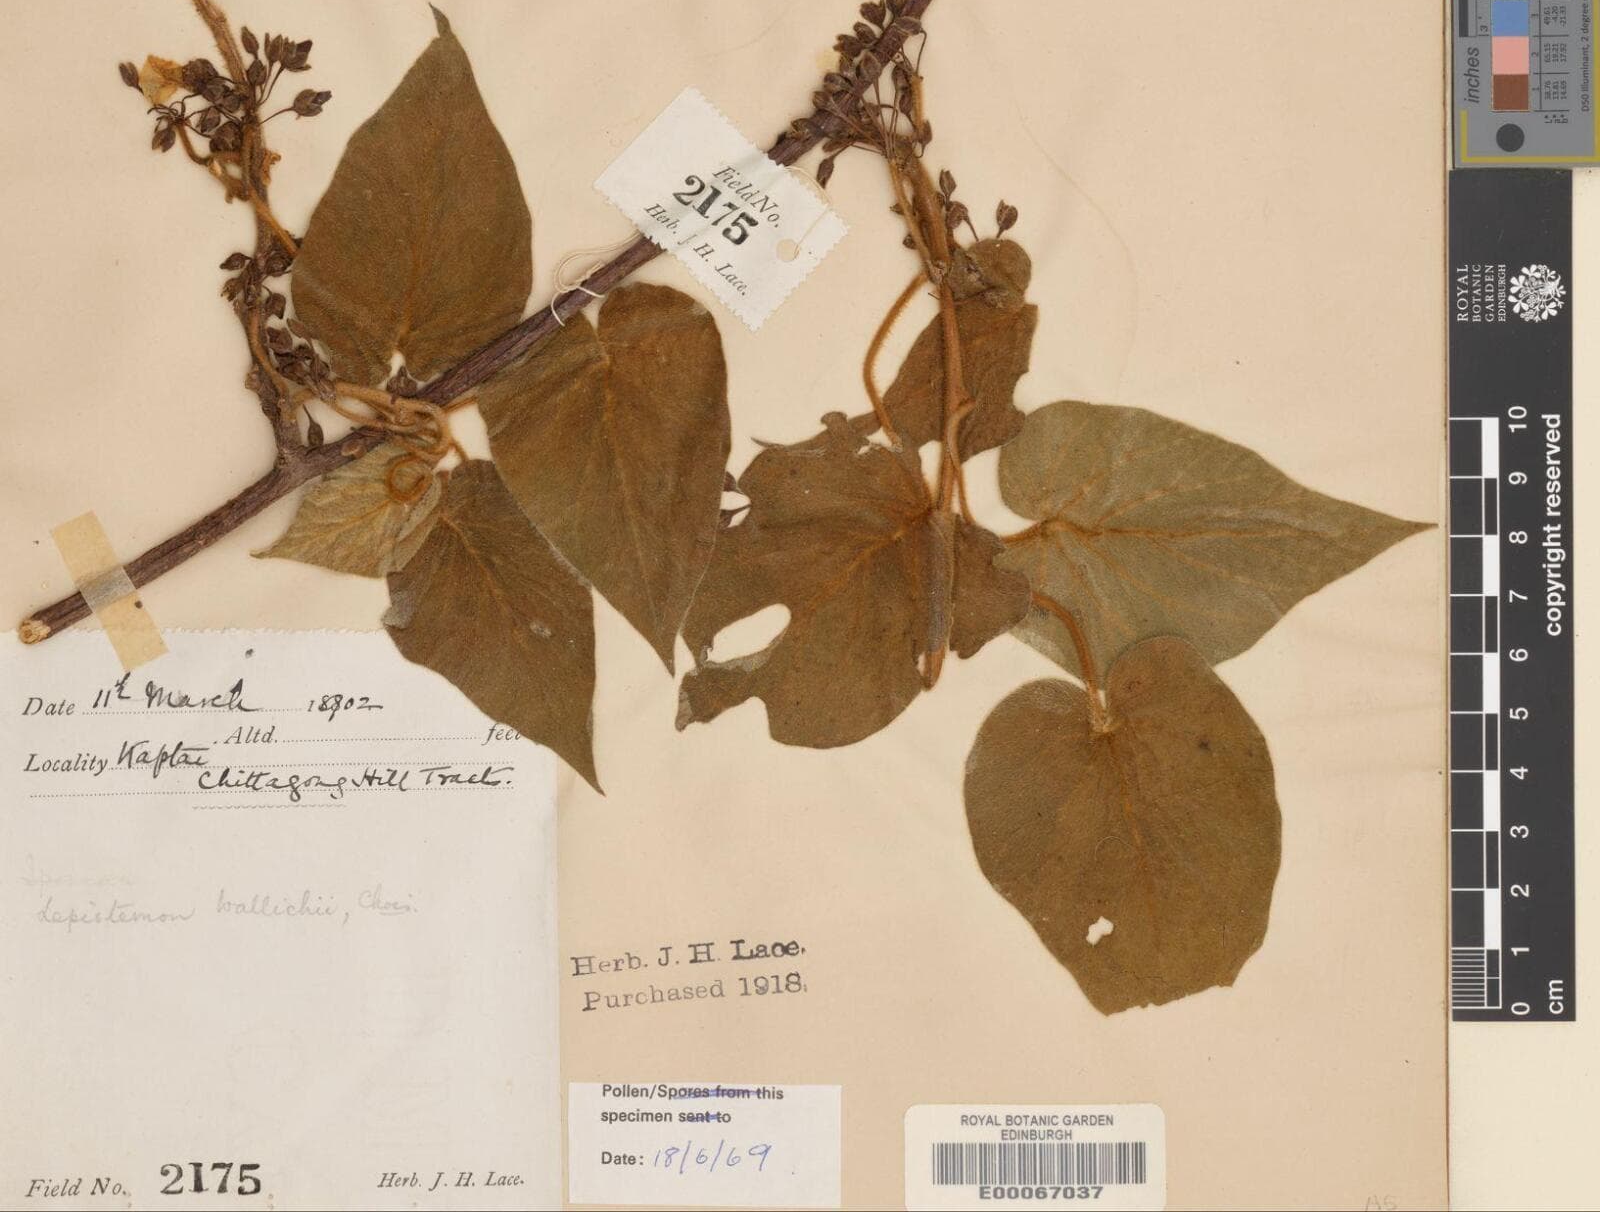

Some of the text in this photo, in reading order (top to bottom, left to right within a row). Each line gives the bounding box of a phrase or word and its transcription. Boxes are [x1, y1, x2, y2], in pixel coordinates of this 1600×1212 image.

[1581, 3, 1590, 33] degree
[1463, 45, 1481, 103] inches
[1581, 93, 1590, 111] D50
[672, 175, 759, 245] 2175
[712, 165, 780, 228] Field No.
[693, 244, 715, 262] H.
[715, 262, 747, 296] Lace.
[1456, 263, 1468, 321] ROYAL
[1472, 263, 1482, 321] BOTANIC
[1485, 263, 1494, 321] GARDEN
[1498, 263, 1506, 321] EDINBURGH
[1542, 413, 1568, 636] copyright reserved
[22, 697, 75, 716] Date
[145, 678, 264, 712] March
[1508, 405, 1530, 1015] 10 9 8 7 6 5 4 3 2 1 0
[224, 726, 278, 745] Altd.
[23, 740, 210, 779] Locality Kaptai
[199, 768, 347, 801] Chittagong
[352, 767, 409, 791] Hill
[570, 952, 648, 976] Herb.
[658, 947, 680, 966] J.
[688, 942, 720, 964] H.
[582, 980, 726, 1012] Purchased
[1546, 978, 1564, 1014] cm
[602, 1084, 784, 1100] Pollen/Spores from this
[601, 1110, 731, 1124] specimen sent to
[961, 1115, 1114, 1126] ROYAL BOTANIC GARDEN
[1001, 1130, 1073, 1141] EDINBURGH
[601, 1139, 772, 1174] Date: 18/6/69
[25, 1162, 262, 1198] Field No. 2175
[377, 1171, 525, 1191] Herb. J. H. Lace.
[979, 1186, 1104, 1200] E00067037
